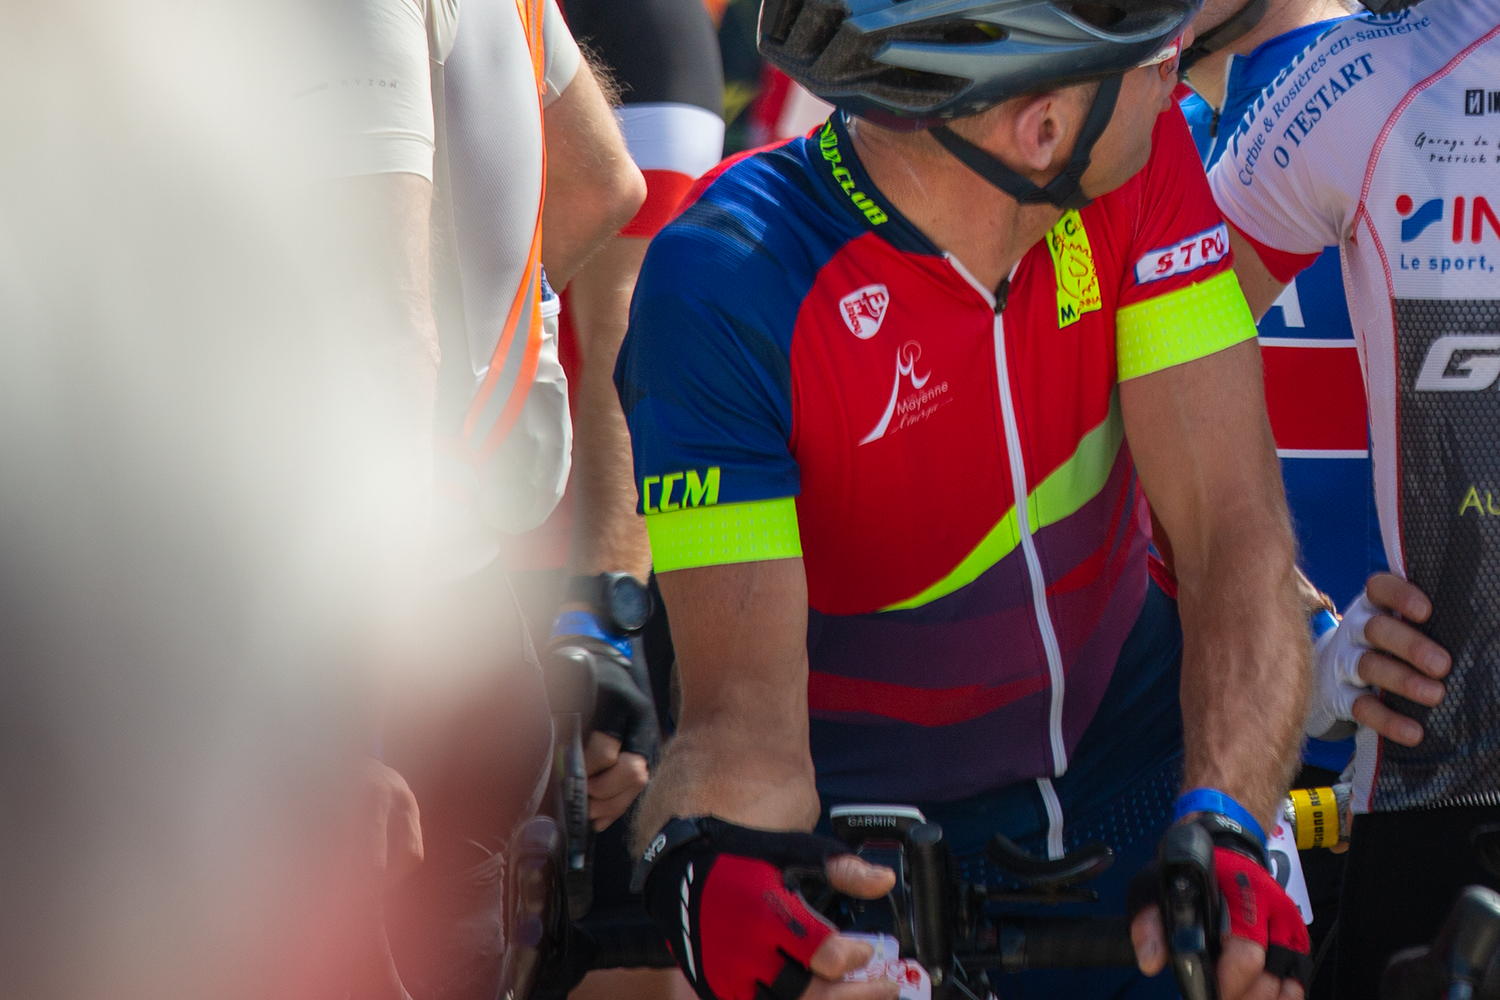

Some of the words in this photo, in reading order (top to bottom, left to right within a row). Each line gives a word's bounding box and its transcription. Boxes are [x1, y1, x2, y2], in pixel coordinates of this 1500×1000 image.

[1283, 52, 1377, 150] TESTART
[1415, 132, 1465, 151] Garage
[1401, 254, 1421, 270] Le
[1429, 255, 1494, 273] sport,
[897, 381, 949, 417] Mayenne
[643, 466, 721, 516] CCM
[847, 815, 898, 829] GARMIN
